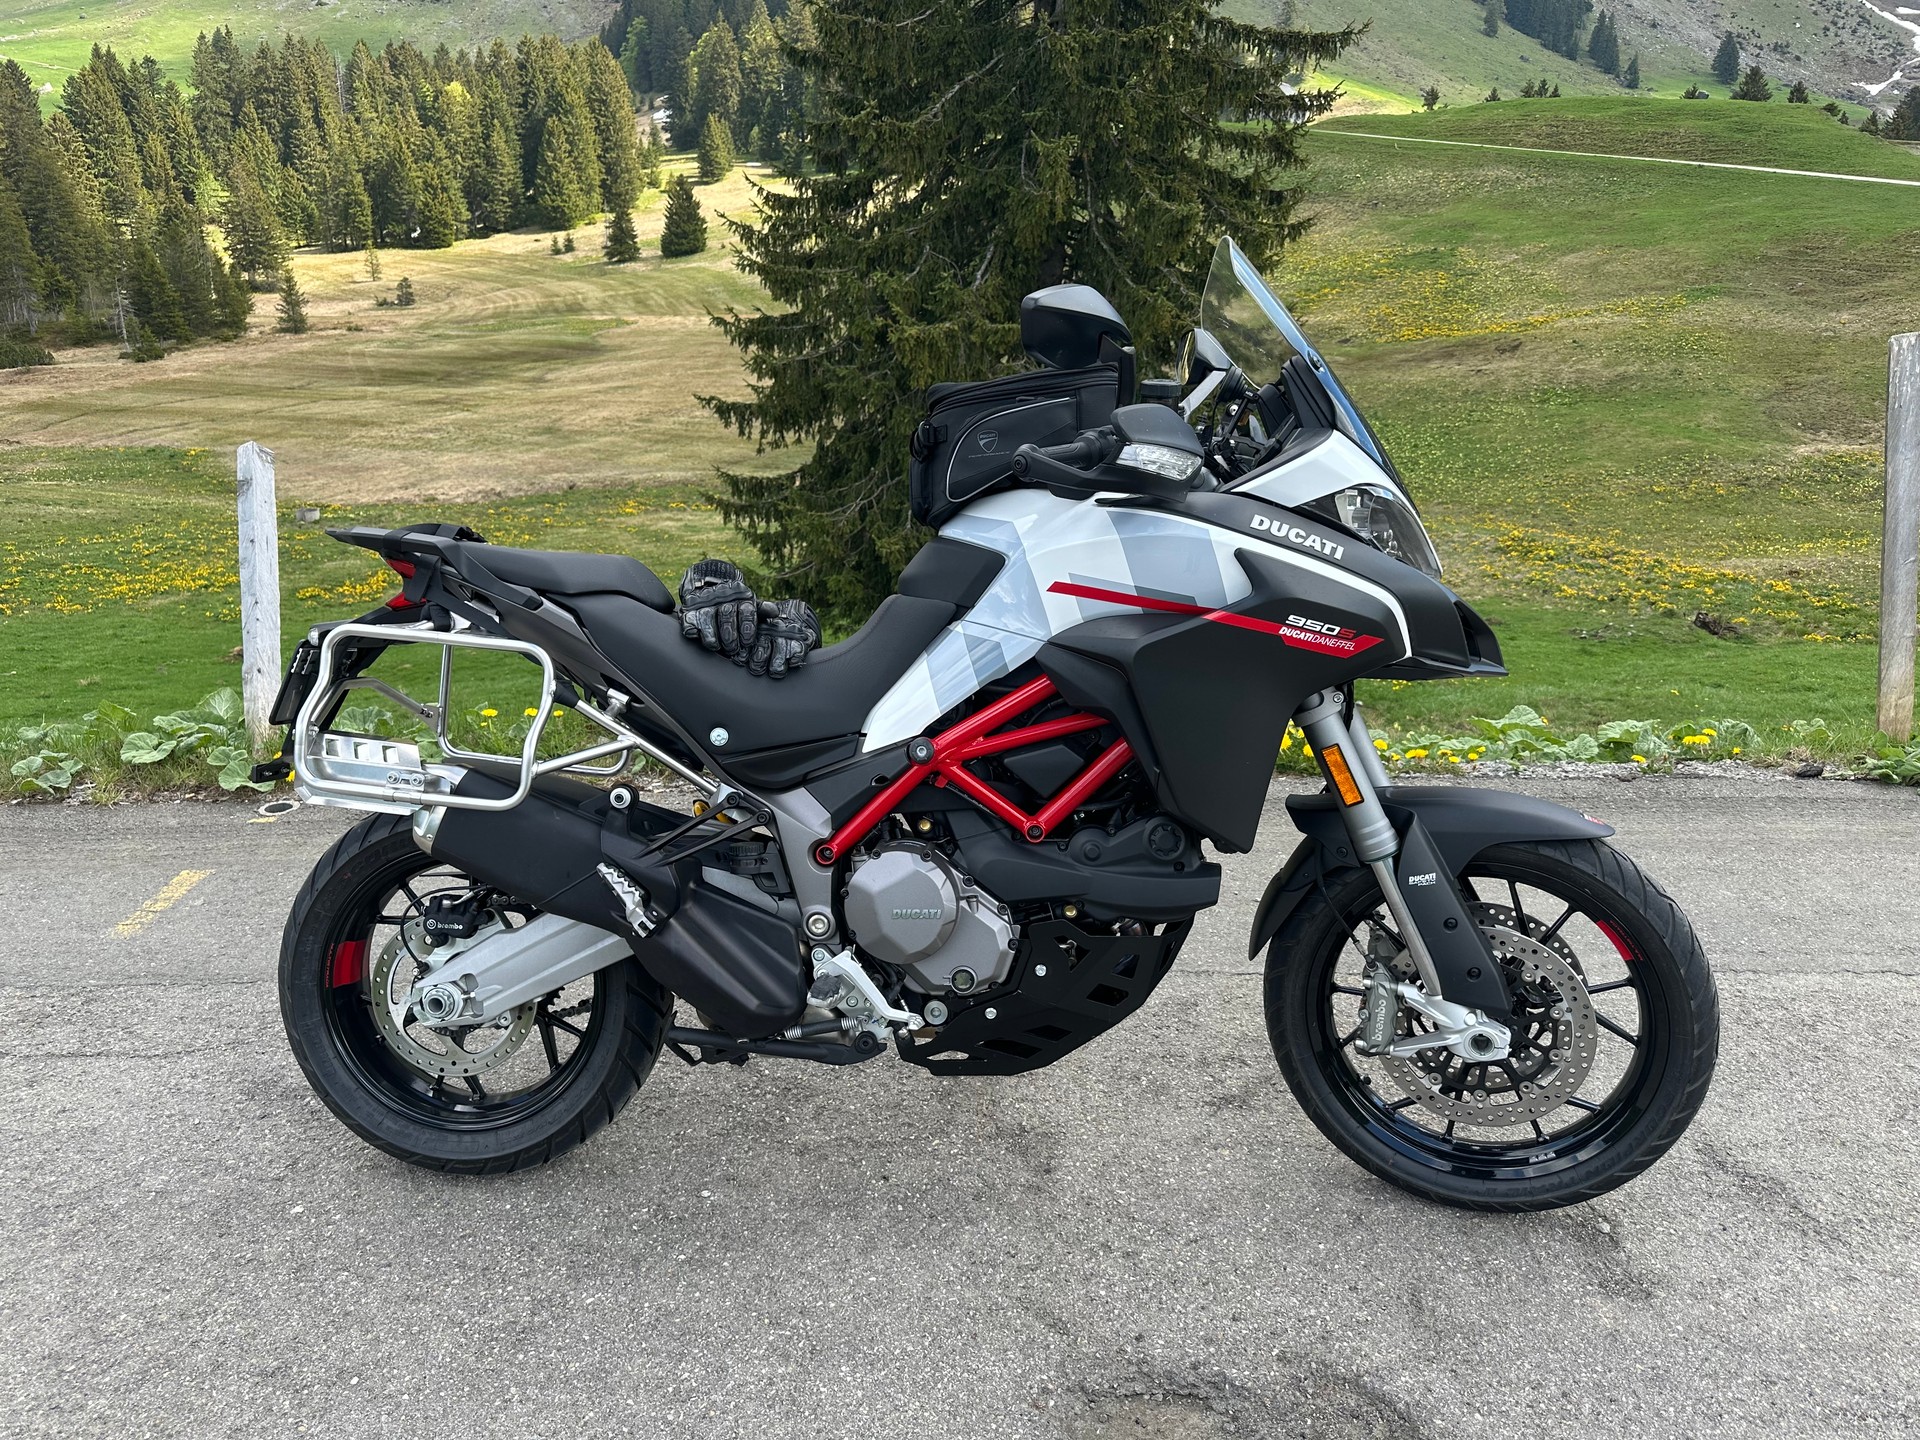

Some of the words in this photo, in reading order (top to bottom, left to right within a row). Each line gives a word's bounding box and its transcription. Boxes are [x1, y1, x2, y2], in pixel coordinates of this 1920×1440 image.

[1249, 514, 1345, 560] DUCATI
[1285, 614, 1357, 639] 950S
[1408, 872, 1436, 881] DUCATI
[891, 908, 943, 920] DUCATI
[437, 921, 464, 930] brembo
[1371, 999, 1387, 1041] brembo
